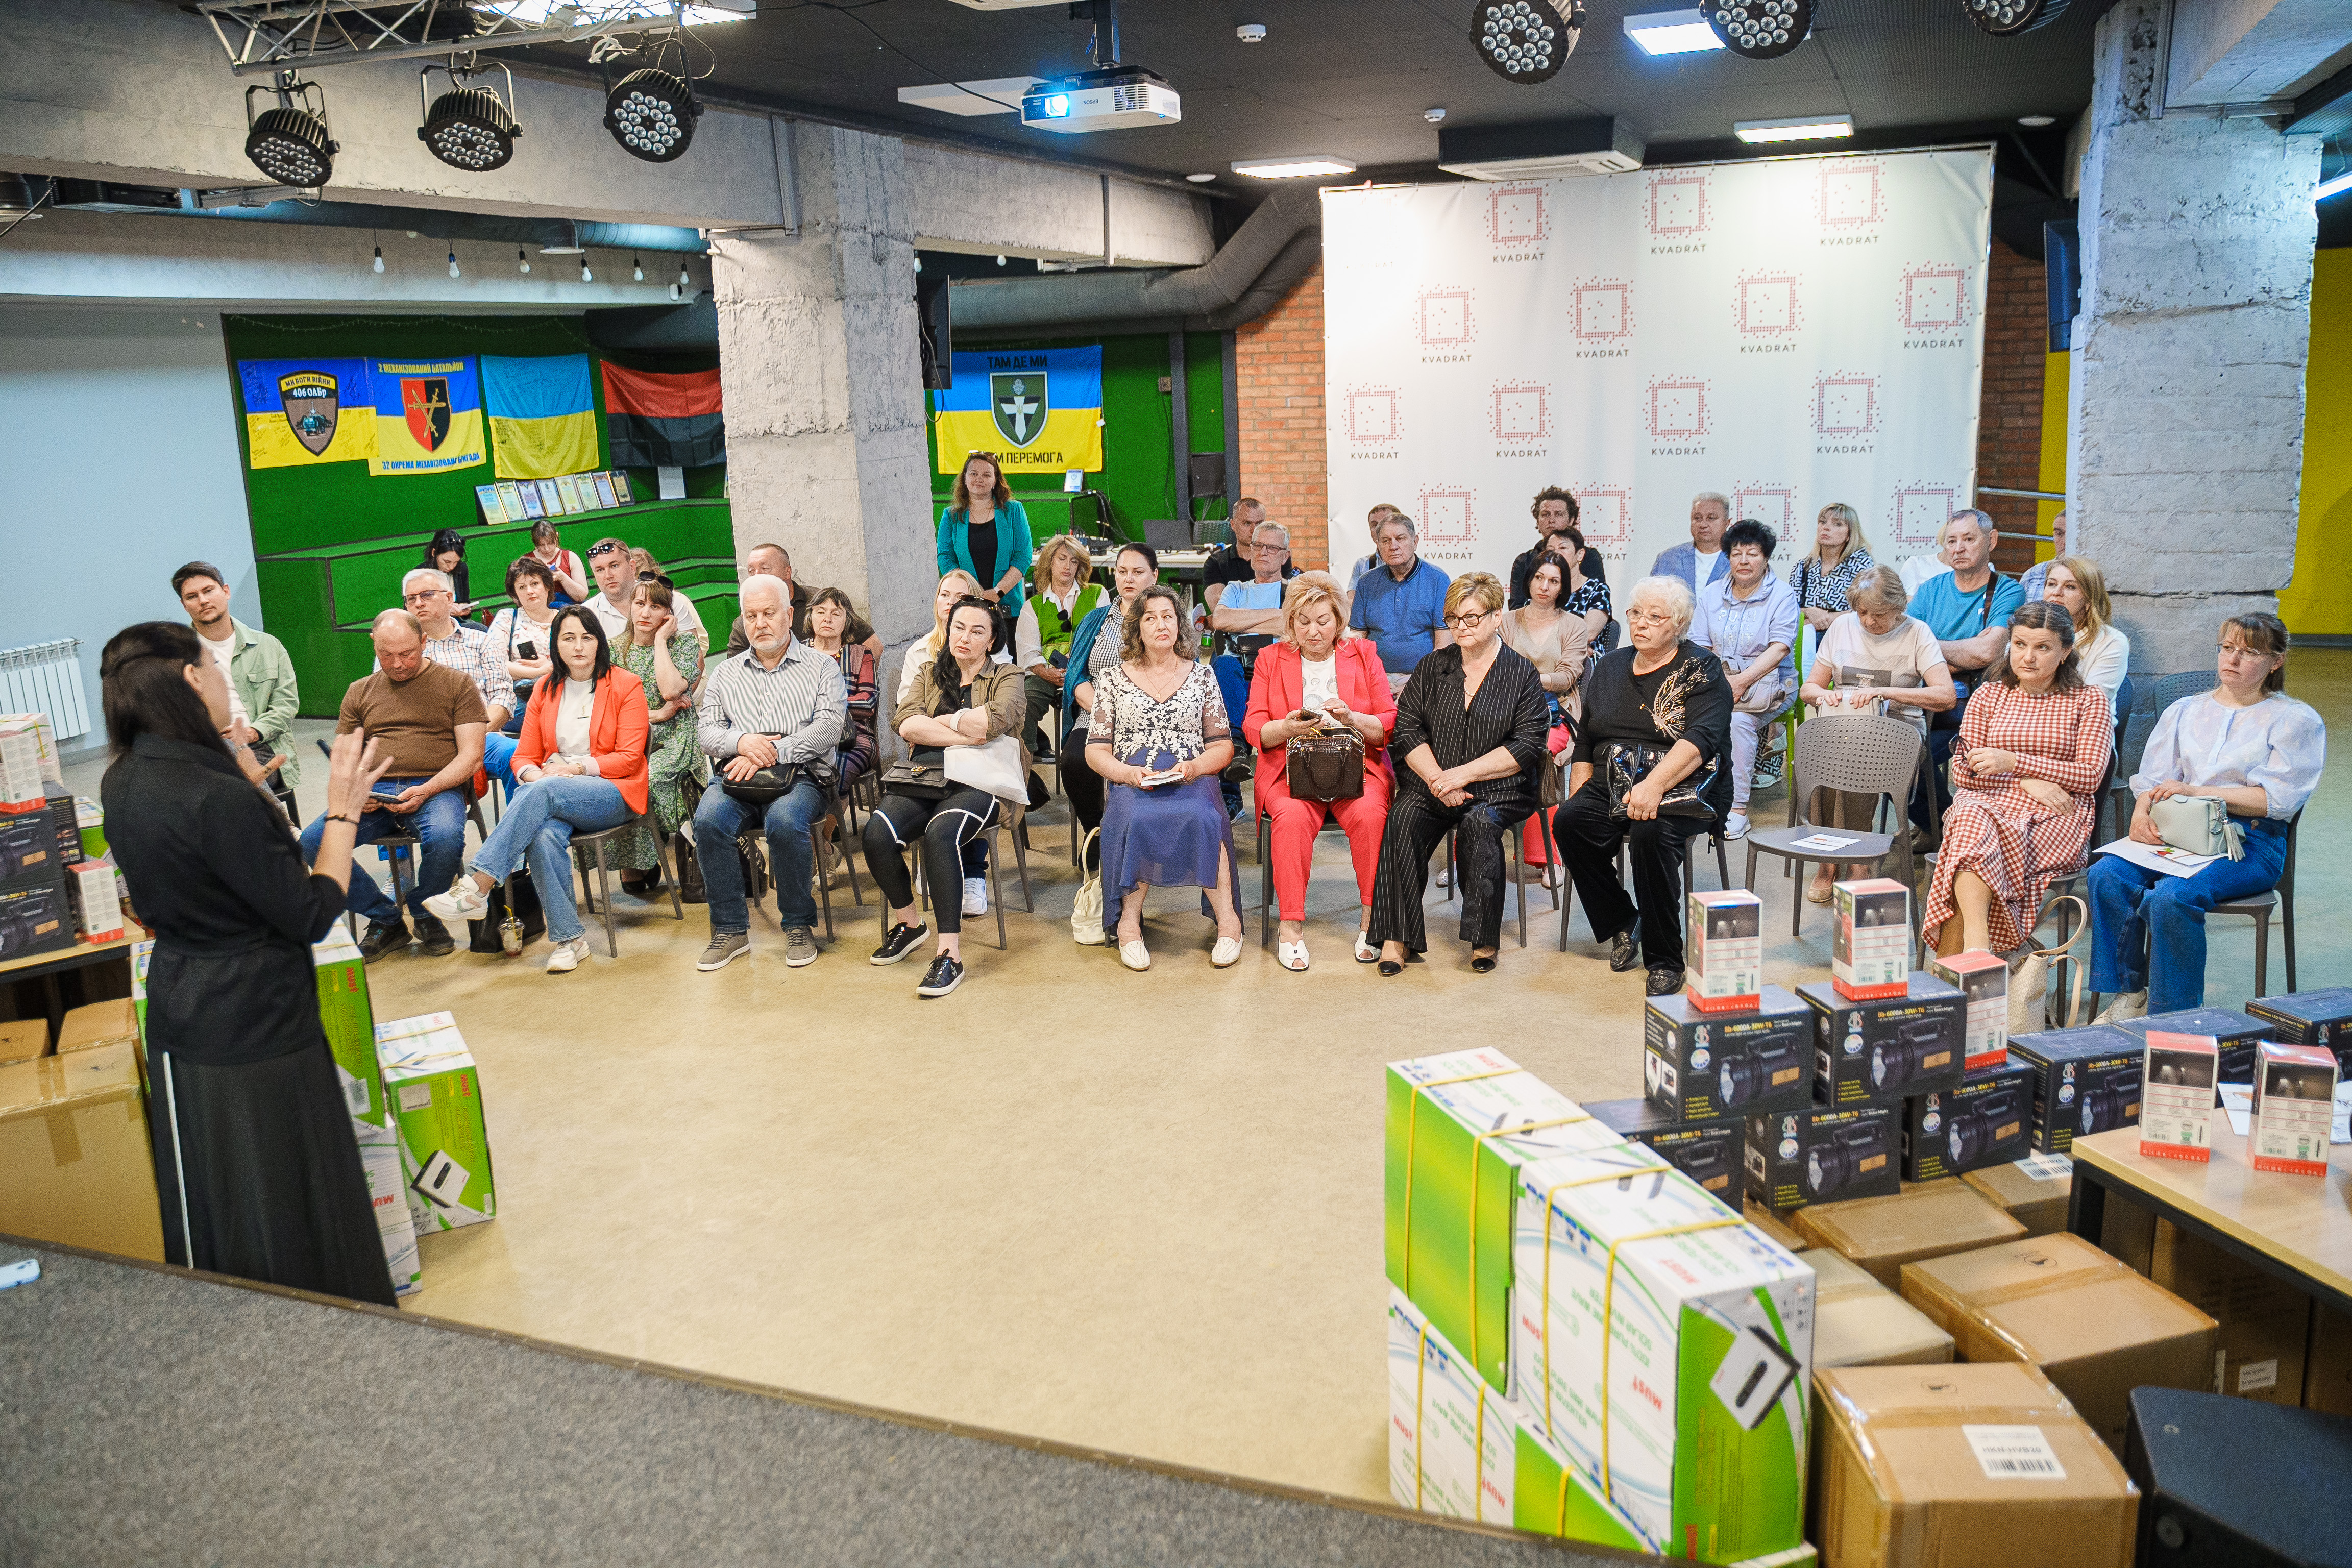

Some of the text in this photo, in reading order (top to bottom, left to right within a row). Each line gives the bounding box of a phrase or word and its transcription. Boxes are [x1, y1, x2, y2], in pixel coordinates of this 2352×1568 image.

[1820, 235, 1879, 247] KVADRAT
[1651, 244, 1706, 255] KVADRAT
[1493, 252, 1546, 263] KVADRAT
[1740, 344, 1797, 353] KVADRAT
[1903, 338, 1965, 349] KVADRAT
[1422, 355, 1472, 363] KVADRAT
[1576, 349, 1630, 359] KVADRAT
[378, 363, 382, 372] 2
[988, 355, 1047, 369] ТАМ ДЕ МИ
[312, 376, 330, 385] ВІЙНИ
[293, 388, 306, 397] 406
[1496, 449, 1548, 458] KVADRAT
[1651, 447, 1706, 456] KVADRAT
[1816, 445, 1874, 454] KVADRAT
[1006, 451, 1064, 464] ПЕРЕМОГА
[1350, 451, 1399, 460] KVADRAT
[1423, 552, 1474, 560] KVADRAT
[1601, 553, 1627, 561] DRAT
[346, 967, 359, 993] MUST
[461, 1074, 472, 1097] MUST
[373, 1194, 394, 1208] MU
[1522, 1312, 1543, 1345] MUS
[1632, 1370, 1662, 1416] MUST
[1393, 1412, 1413, 1444] MUST
[1481, 1473, 1505, 1511] MUST
